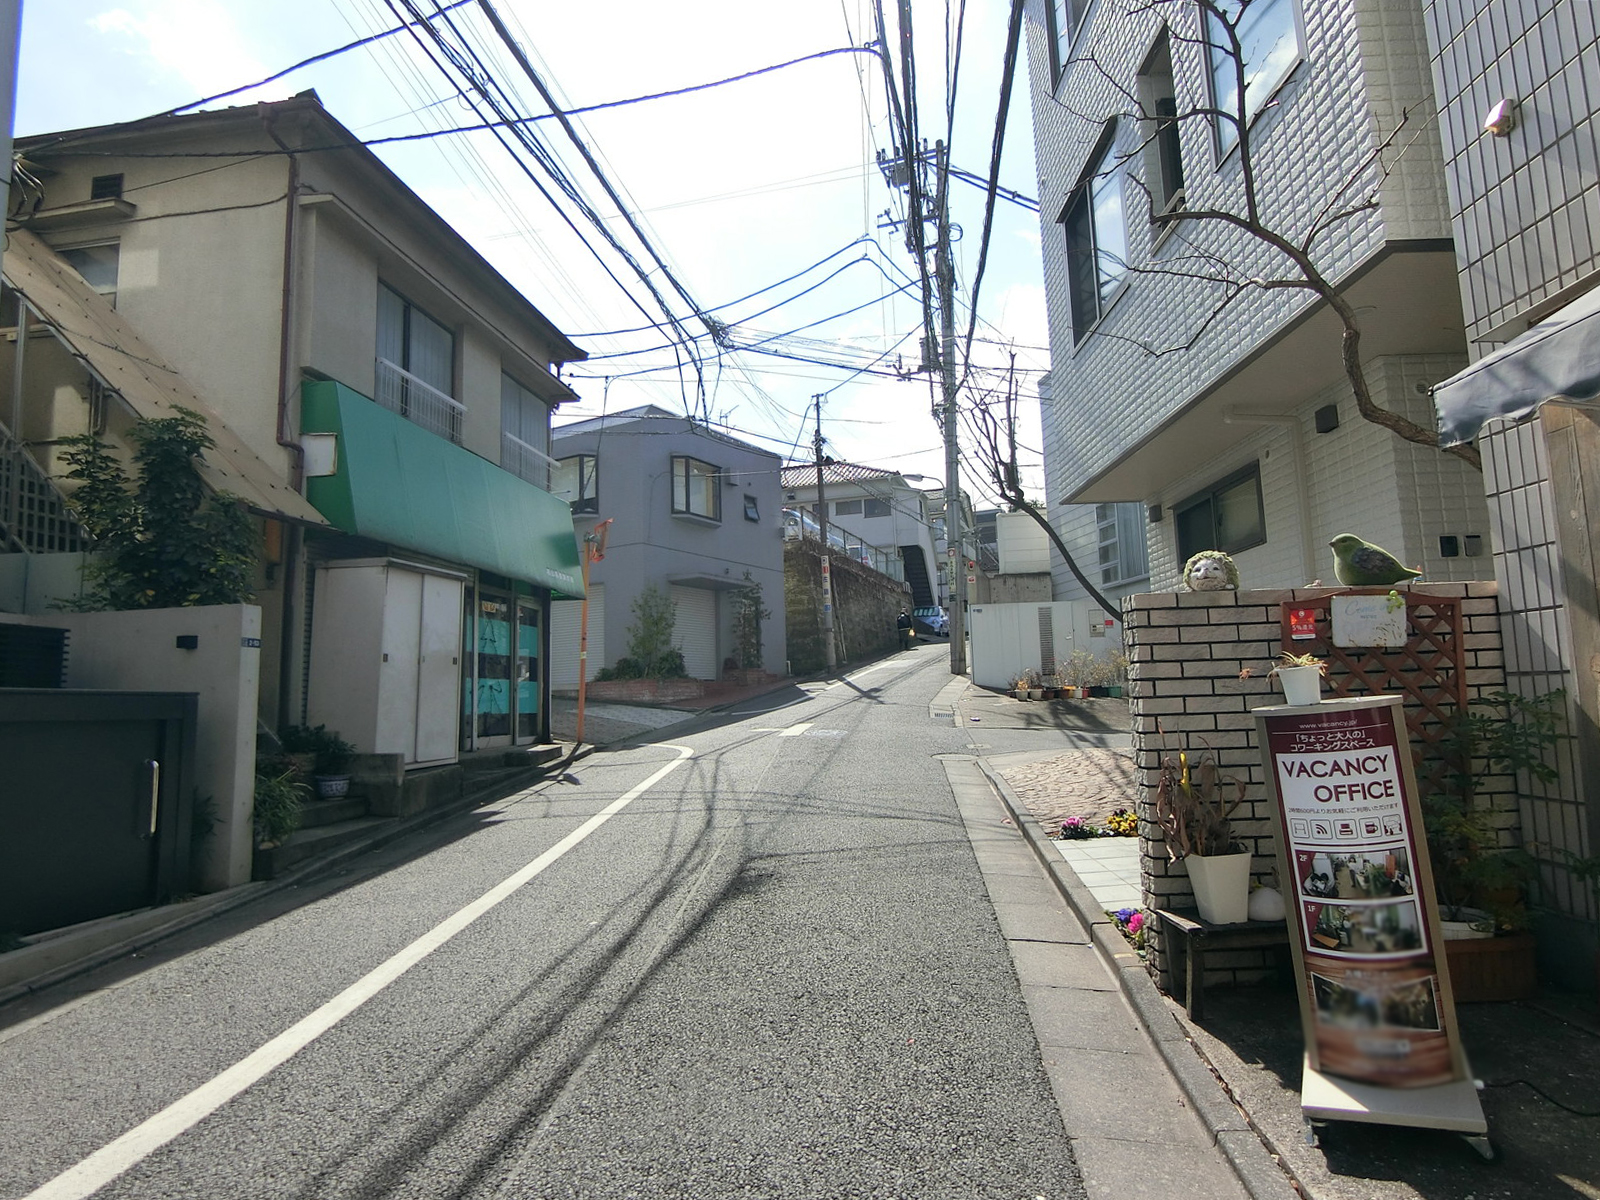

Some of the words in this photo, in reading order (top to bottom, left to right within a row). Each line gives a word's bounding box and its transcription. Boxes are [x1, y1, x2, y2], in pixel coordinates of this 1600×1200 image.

[1295, 730, 1366, 742] 「ちょっと大人の」
[1290, 738, 1375, 752] コワーキングスペース
[1281, 754, 1389, 778] VACANCY
[1313, 779, 1395, 803] OFFICE
[1299, 854, 1308, 862] 2F
[1307, 904, 1316, 913] 1F
